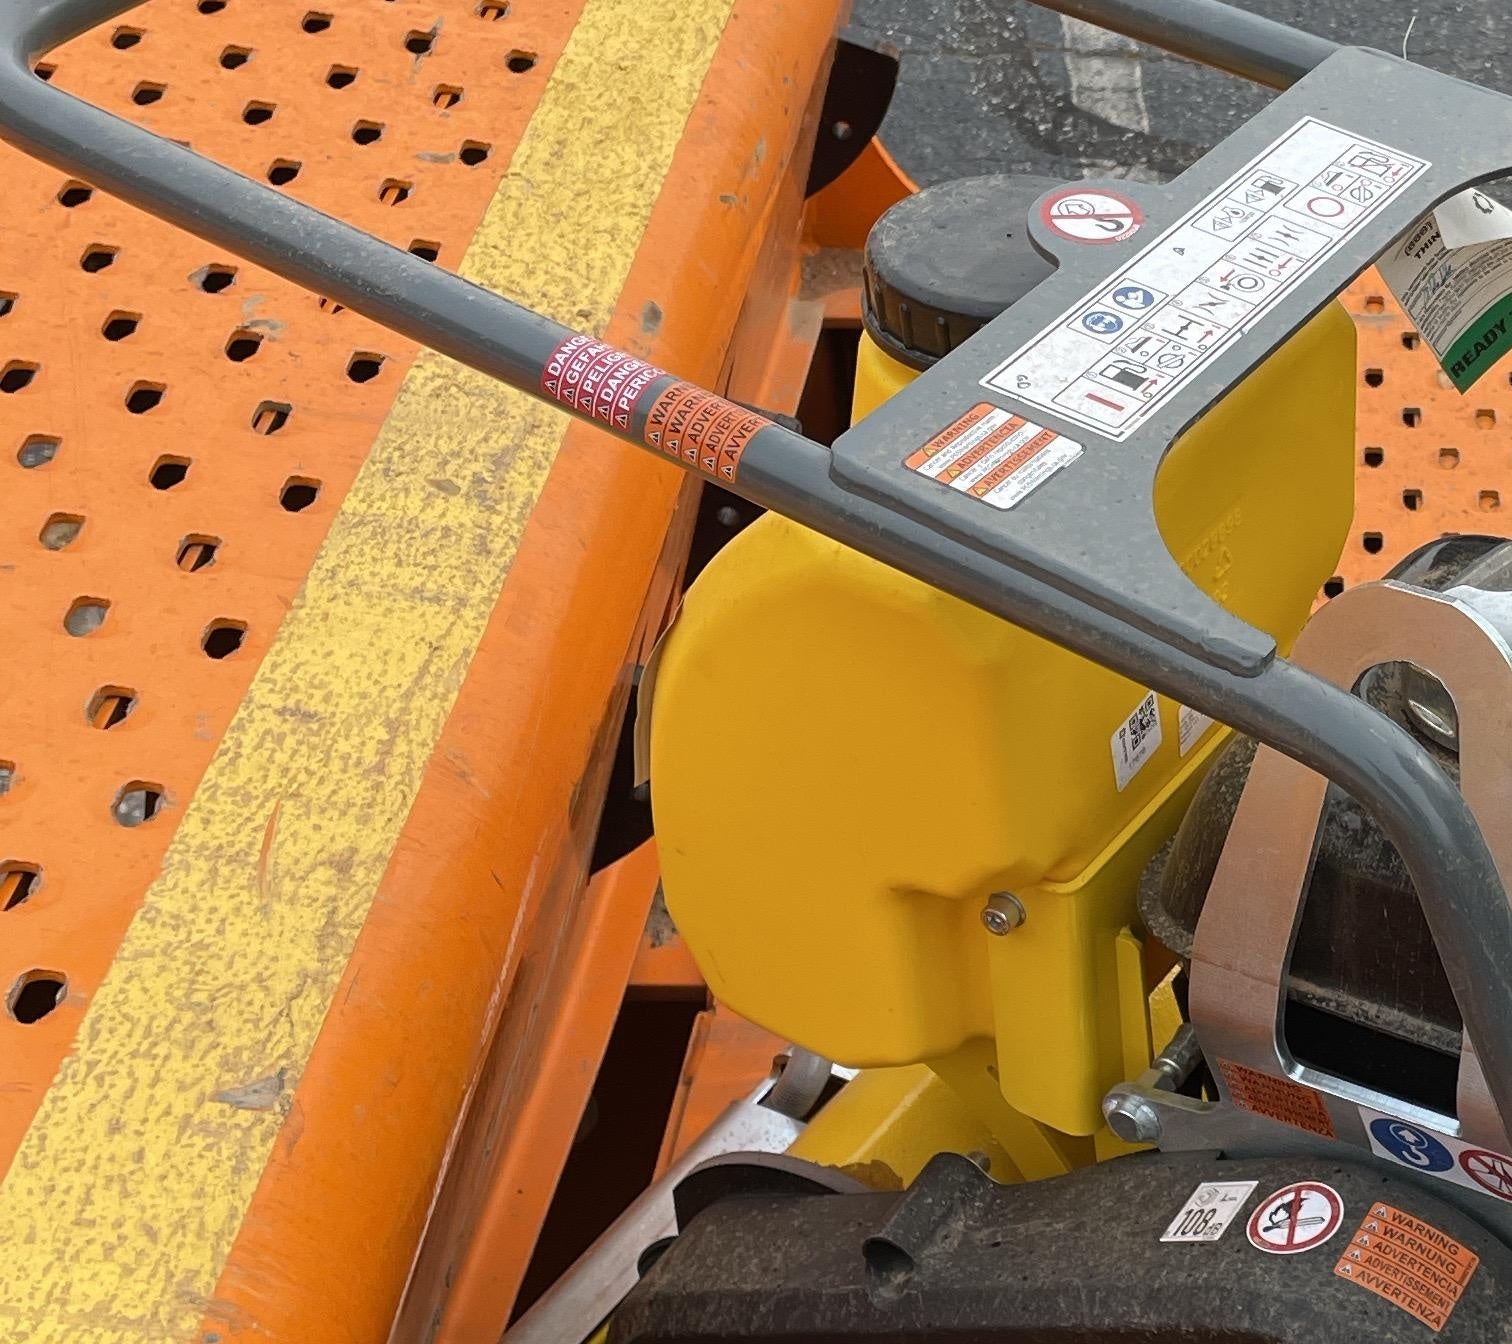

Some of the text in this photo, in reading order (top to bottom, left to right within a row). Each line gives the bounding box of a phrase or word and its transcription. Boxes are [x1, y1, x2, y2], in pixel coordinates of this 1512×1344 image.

[1451, 318, 1507, 378] READY
[931, 413, 980, 449] WARNING
[958, 420, 1018, 470] ADVERTENCIA
[1172, 1208, 1217, 1237] 108
[1391, 1211, 1460, 1256] WARNING
[1373, 1241, 1458, 1298] ADVERTENCIA
[1383, 1225, 1457, 1275] WARNUNG
[1355, 1269, 1441, 1328] AVVERTENZA
[1364, 1254, 1450, 1311] ADVERTISSEMENT
